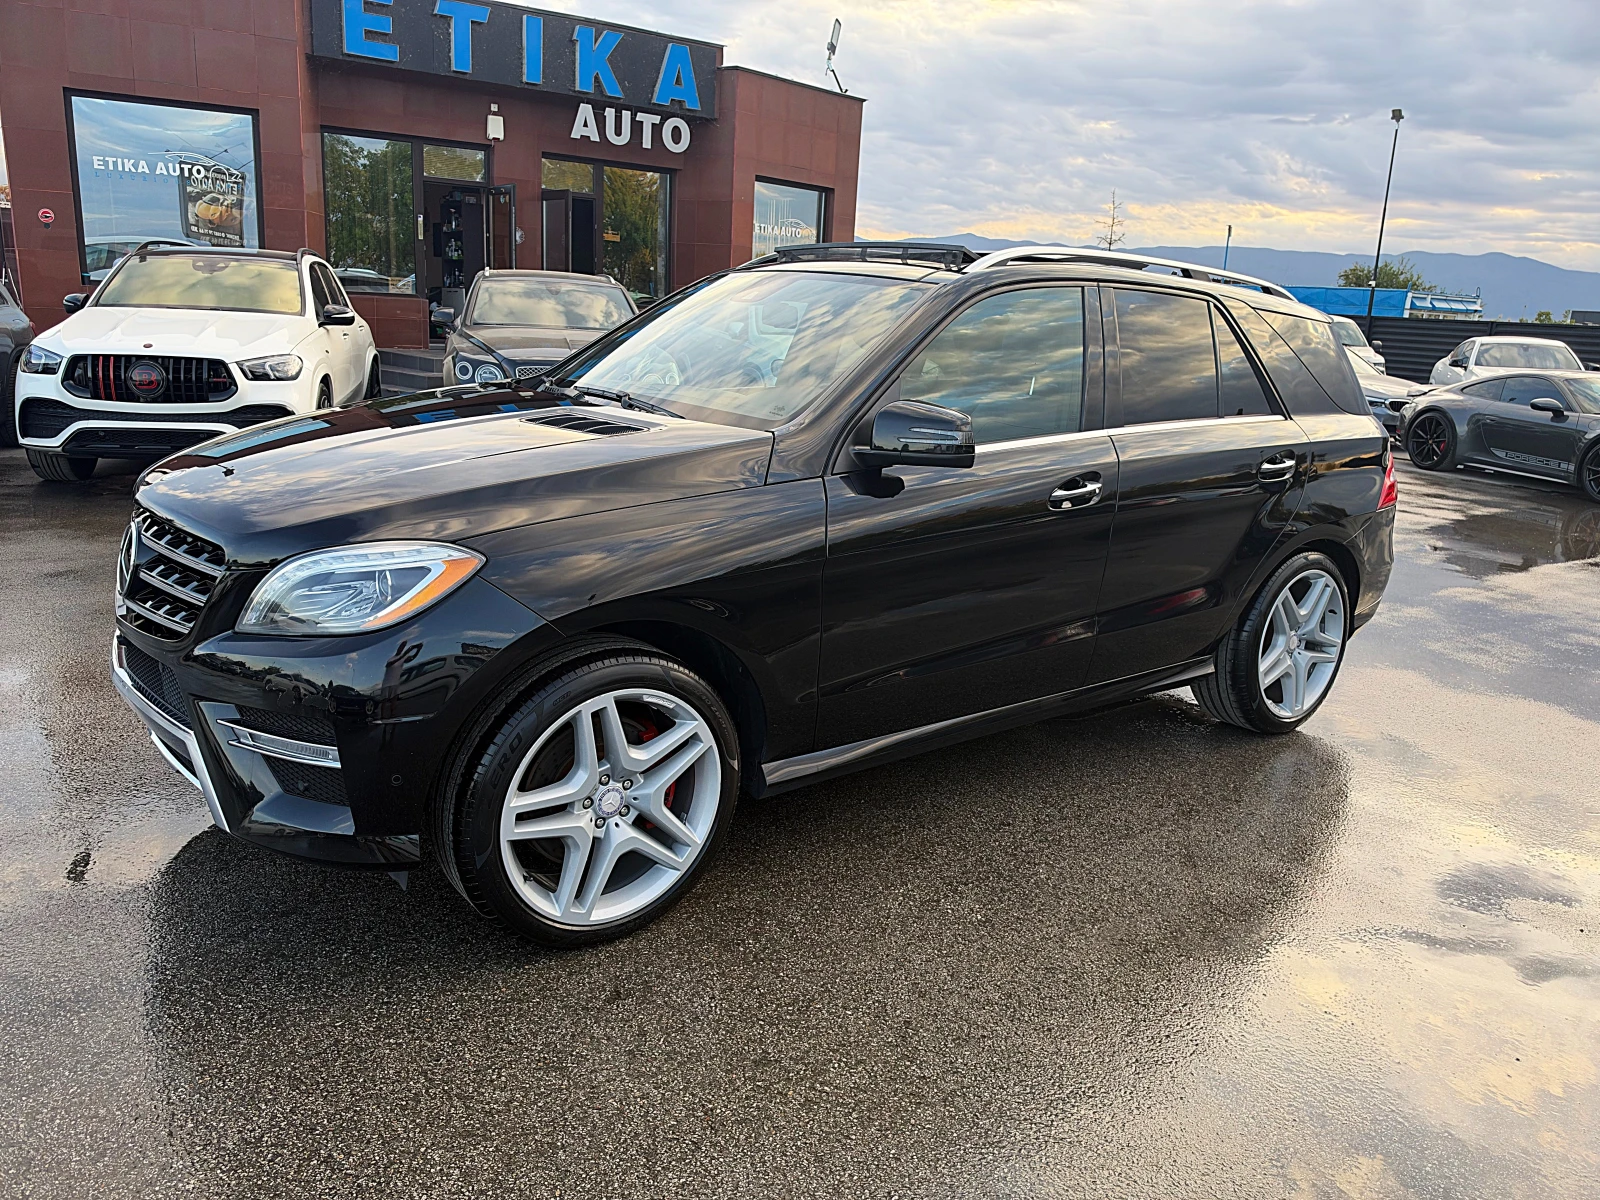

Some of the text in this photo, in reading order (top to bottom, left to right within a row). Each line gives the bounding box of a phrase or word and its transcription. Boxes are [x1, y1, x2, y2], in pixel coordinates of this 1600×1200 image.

[342, 0, 701, 110] ETIKA
[570, 102, 691, 153] AUTO
[92, 155, 150, 174] ETIKA
[155, 161, 205, 178] AUTO
[754, 223, 802, 238] ETIKA AUTO
[1507, 452, 1559, 468] PORSCHE
